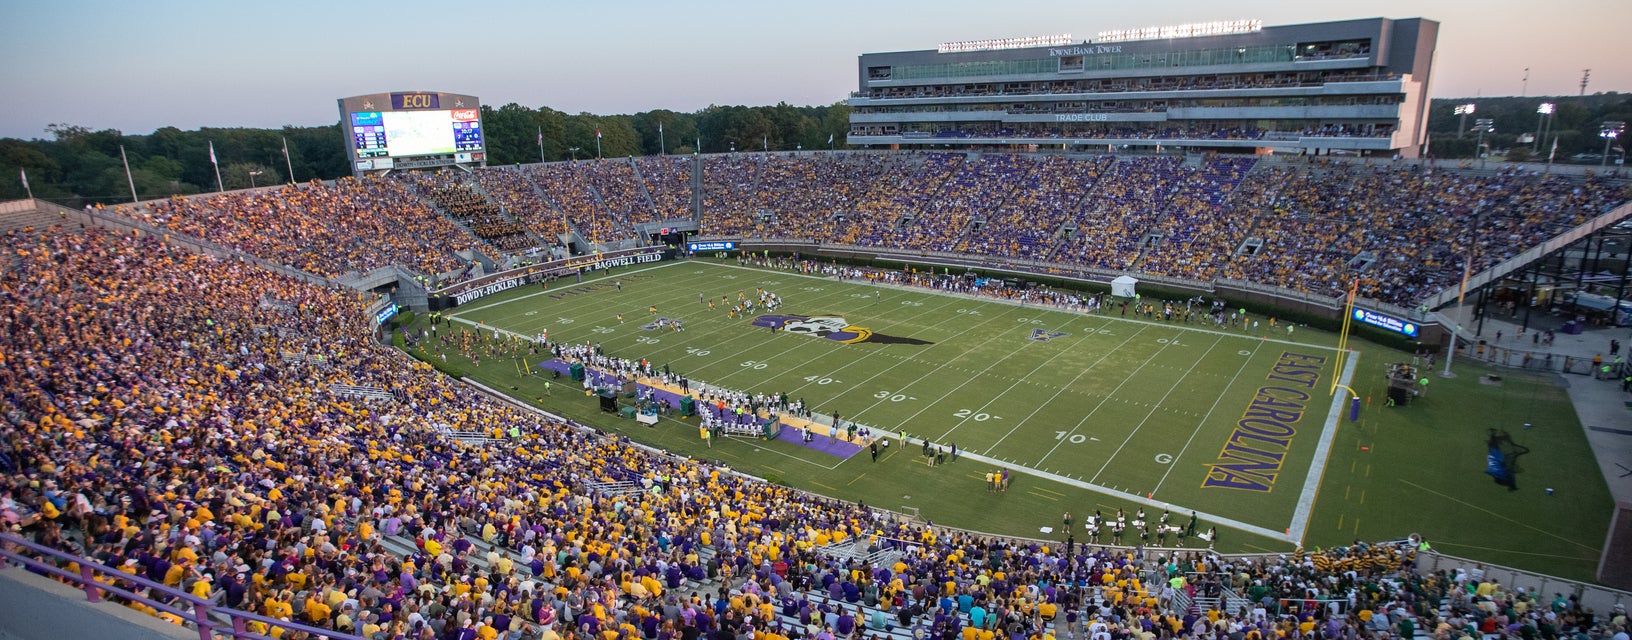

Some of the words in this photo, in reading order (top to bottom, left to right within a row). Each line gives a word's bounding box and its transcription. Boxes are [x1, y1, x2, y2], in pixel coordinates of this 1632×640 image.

[1096, 44, 1122, 54] TOWER
[402, 94, 431, 108] ECU
[456, 278, 518, 306] DOWDY-FICKLEN
[594, 256, 636, 270] BAGWELL
[637, 253, 662, 264] FIELD
[739, 359, 768, 370] 50
[1267, 351, 1328, 388] EAST
[804, 374, 833, 385] 40
[873, 390, 906, 402] 30
[953, 408, 990, 422] 20
[1054, 430, 1087, 444] 10
[1200, 386, 1311, 493] CAROLINA
[1154, 453, 1173, 465] G
